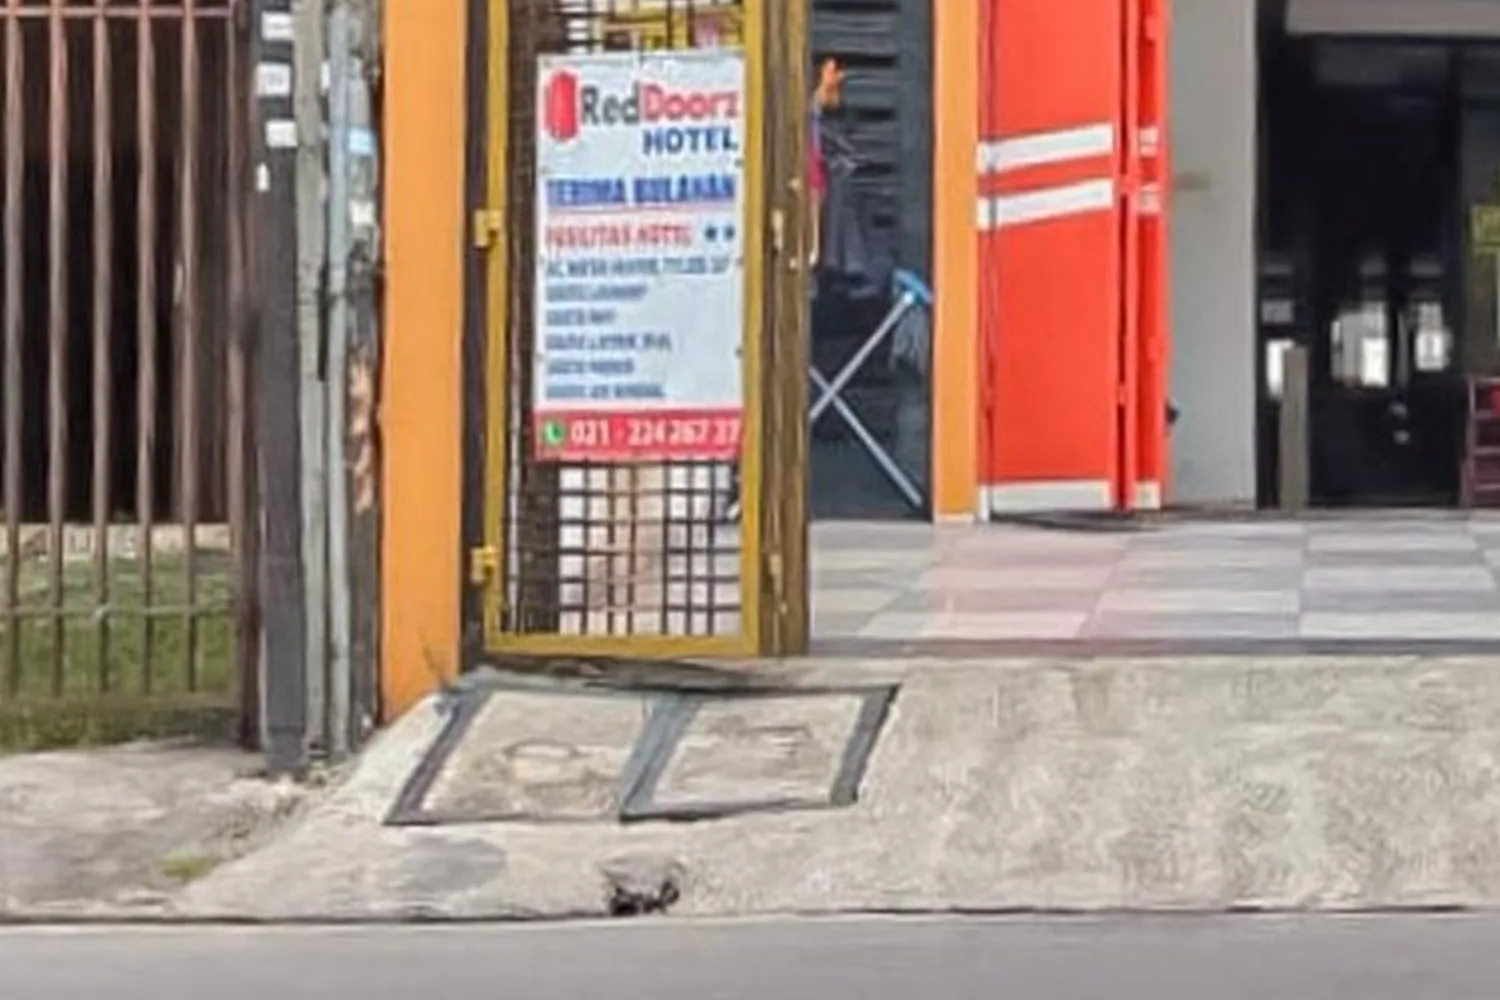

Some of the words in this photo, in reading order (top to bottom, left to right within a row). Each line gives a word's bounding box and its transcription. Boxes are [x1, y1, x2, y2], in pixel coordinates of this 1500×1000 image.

[580, 80, 739, 125] RedDoorz
[642, 127, 739, 153] HOTEL
[570, 418, 609, 446] 021
